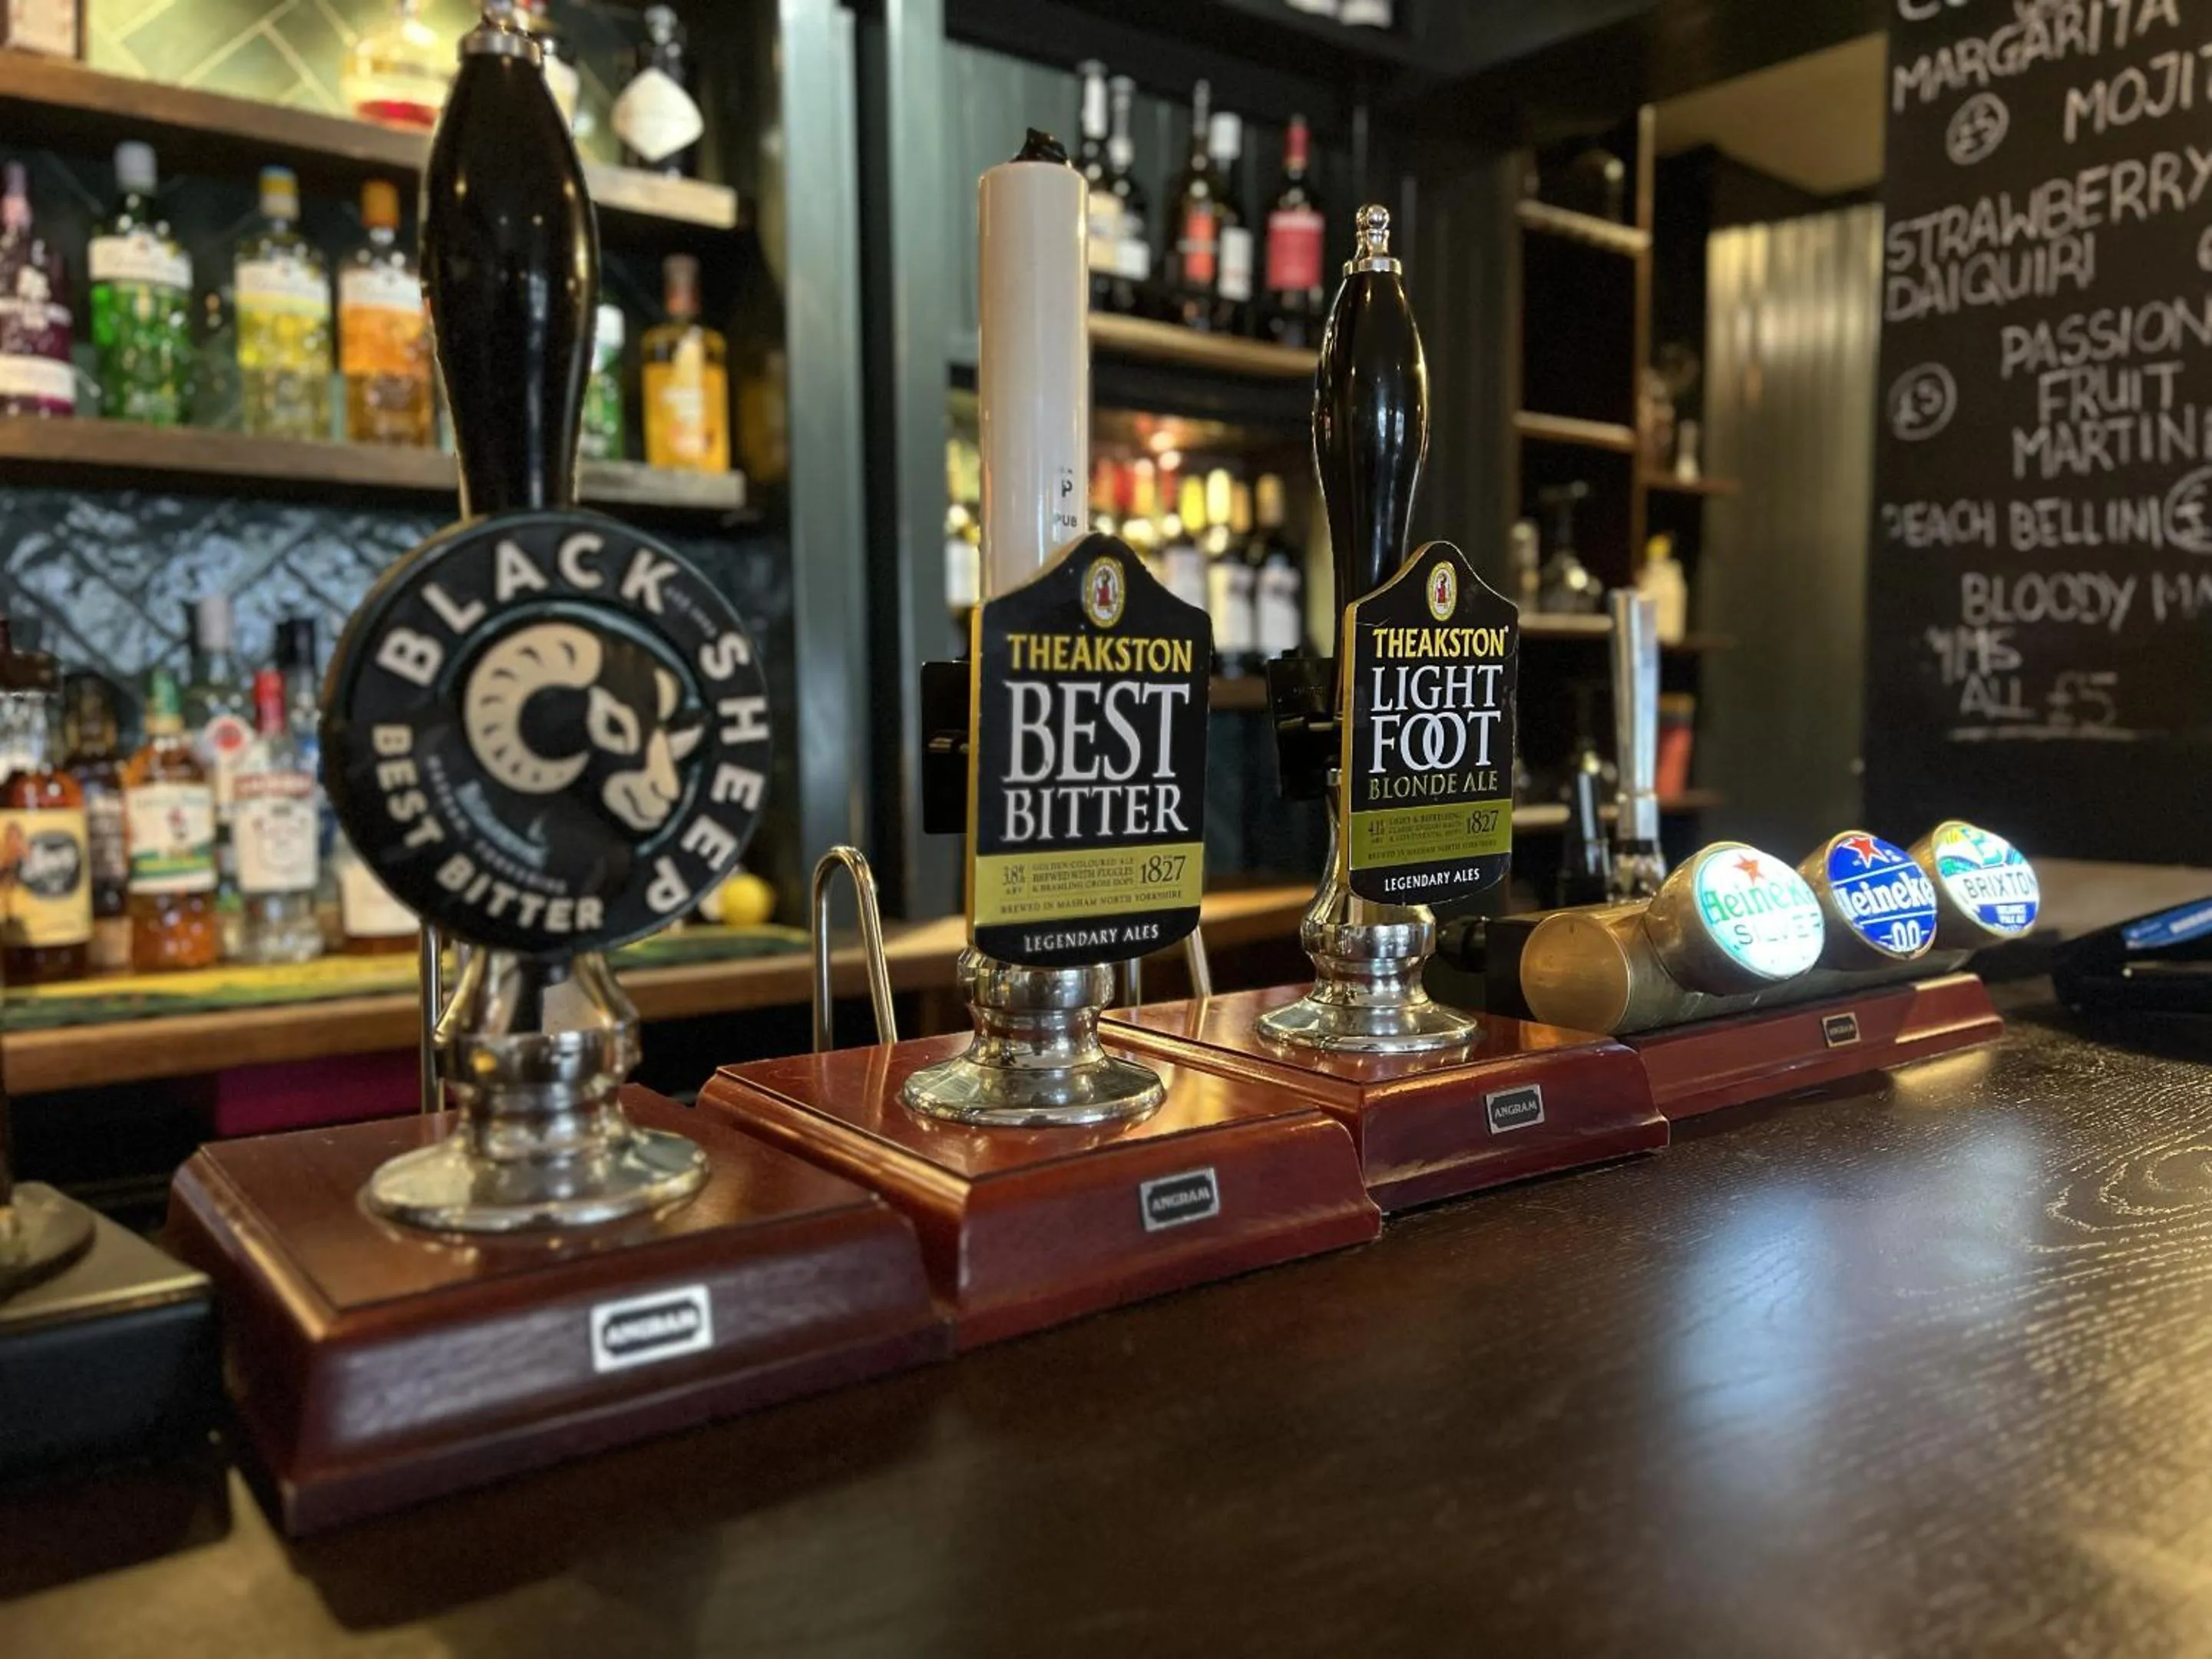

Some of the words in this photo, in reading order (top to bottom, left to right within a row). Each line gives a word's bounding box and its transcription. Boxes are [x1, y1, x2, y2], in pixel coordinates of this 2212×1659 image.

[1892, 0, 2181, 113] MARGARITA
[1885, 145, 2212, 272] STRAWBERRY
[1884, 232, 2096, 322] DAIQUIRI
[2000, 294, 2212, 380] PASSION
[2038, 360, 2185, 423] FRUIT
[2008, 495, 2164, 551] BELLINI
[1960, 572, 2138, 633] BLOODY
[1006, 634, 1193, 673] THEAKSTON
[1372, 627, 1505, 658] THEAKSTON
[1371, 665, 1503, 712] LIGHT
[377, 534, 678, 686] BLACK
[646, 632, 769, 914] SHEEP
[1002, 680, 1191, 784] BEST
[1368, 710, 1501, 774] FOOT
[1000, 784, 1189, 842] BITTER
[1368, 773, 1457, 801] BLONDE
[1462, 770, 1498, 792] ALE
[372, 724, 445, 849] BEST
[436, 853, 604, 933] BITTER
[1466, 810, 1499, 834] 1827
[1139, 854, 1186, 884] 1827
[1384, 871, 1450, 891] LEGENDARY
[1453, 868, 1480, 883] ALES
[1023, 928, 1118, 953] LEGENDARY
[1123, 924, 1159, 942] ALES
[1494, 1099, 1537, 1119] ANGRAM
